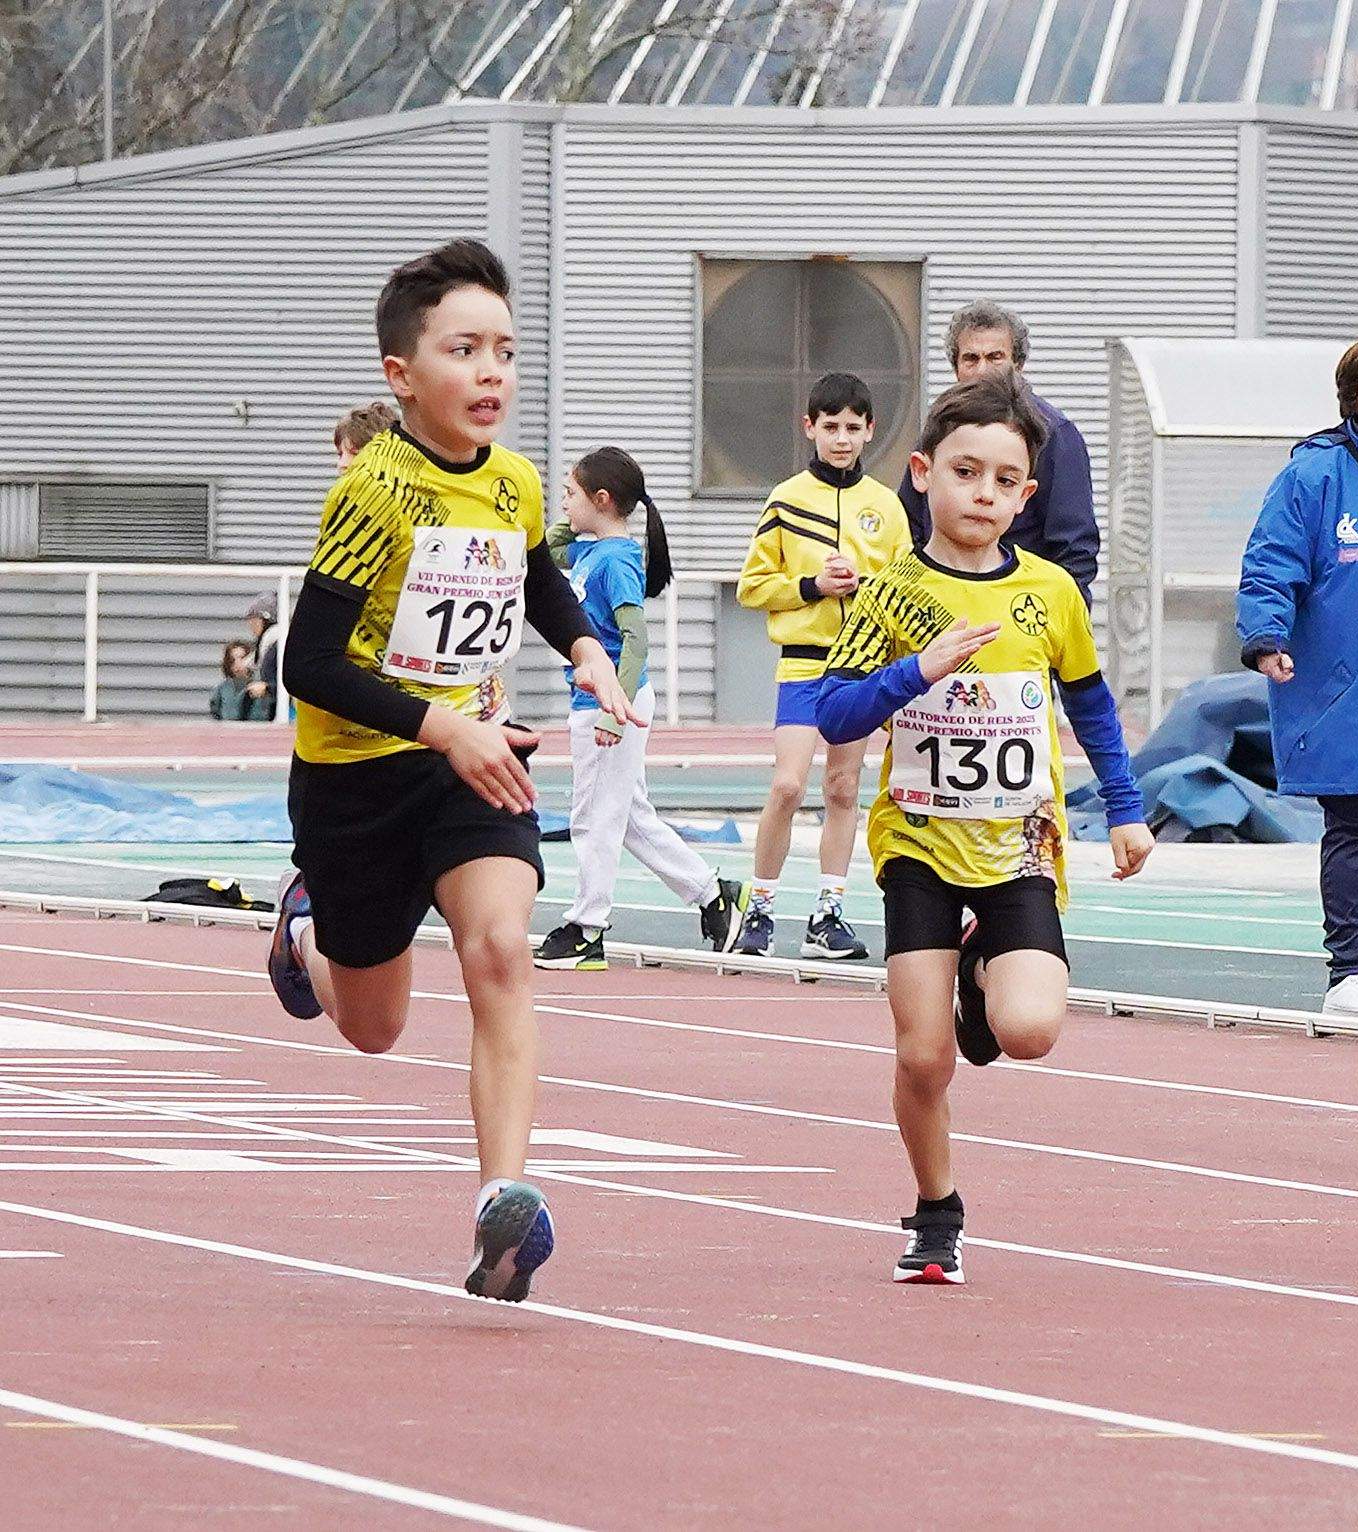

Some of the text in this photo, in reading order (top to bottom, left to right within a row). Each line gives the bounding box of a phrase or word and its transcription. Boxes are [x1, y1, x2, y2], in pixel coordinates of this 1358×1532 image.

[418, 571, 433, 581] VII
[437, 573, 478, 585] TORNEO
[407, 583, 440, 595] GRAN
[443, 587, 484, 599] PREMIO
[426, 597, 517, 656] 125
[902, 708, 917, 718] VII
[919, 711, 965, 725] TORNEO
[968, 716, 984, 725] DE
[987, 716, 1013, 725] REIS
[896, 720, 1042, 738] GRAN PREMIO JIM SPORTS
[915, 736, 1035, 792] 130
